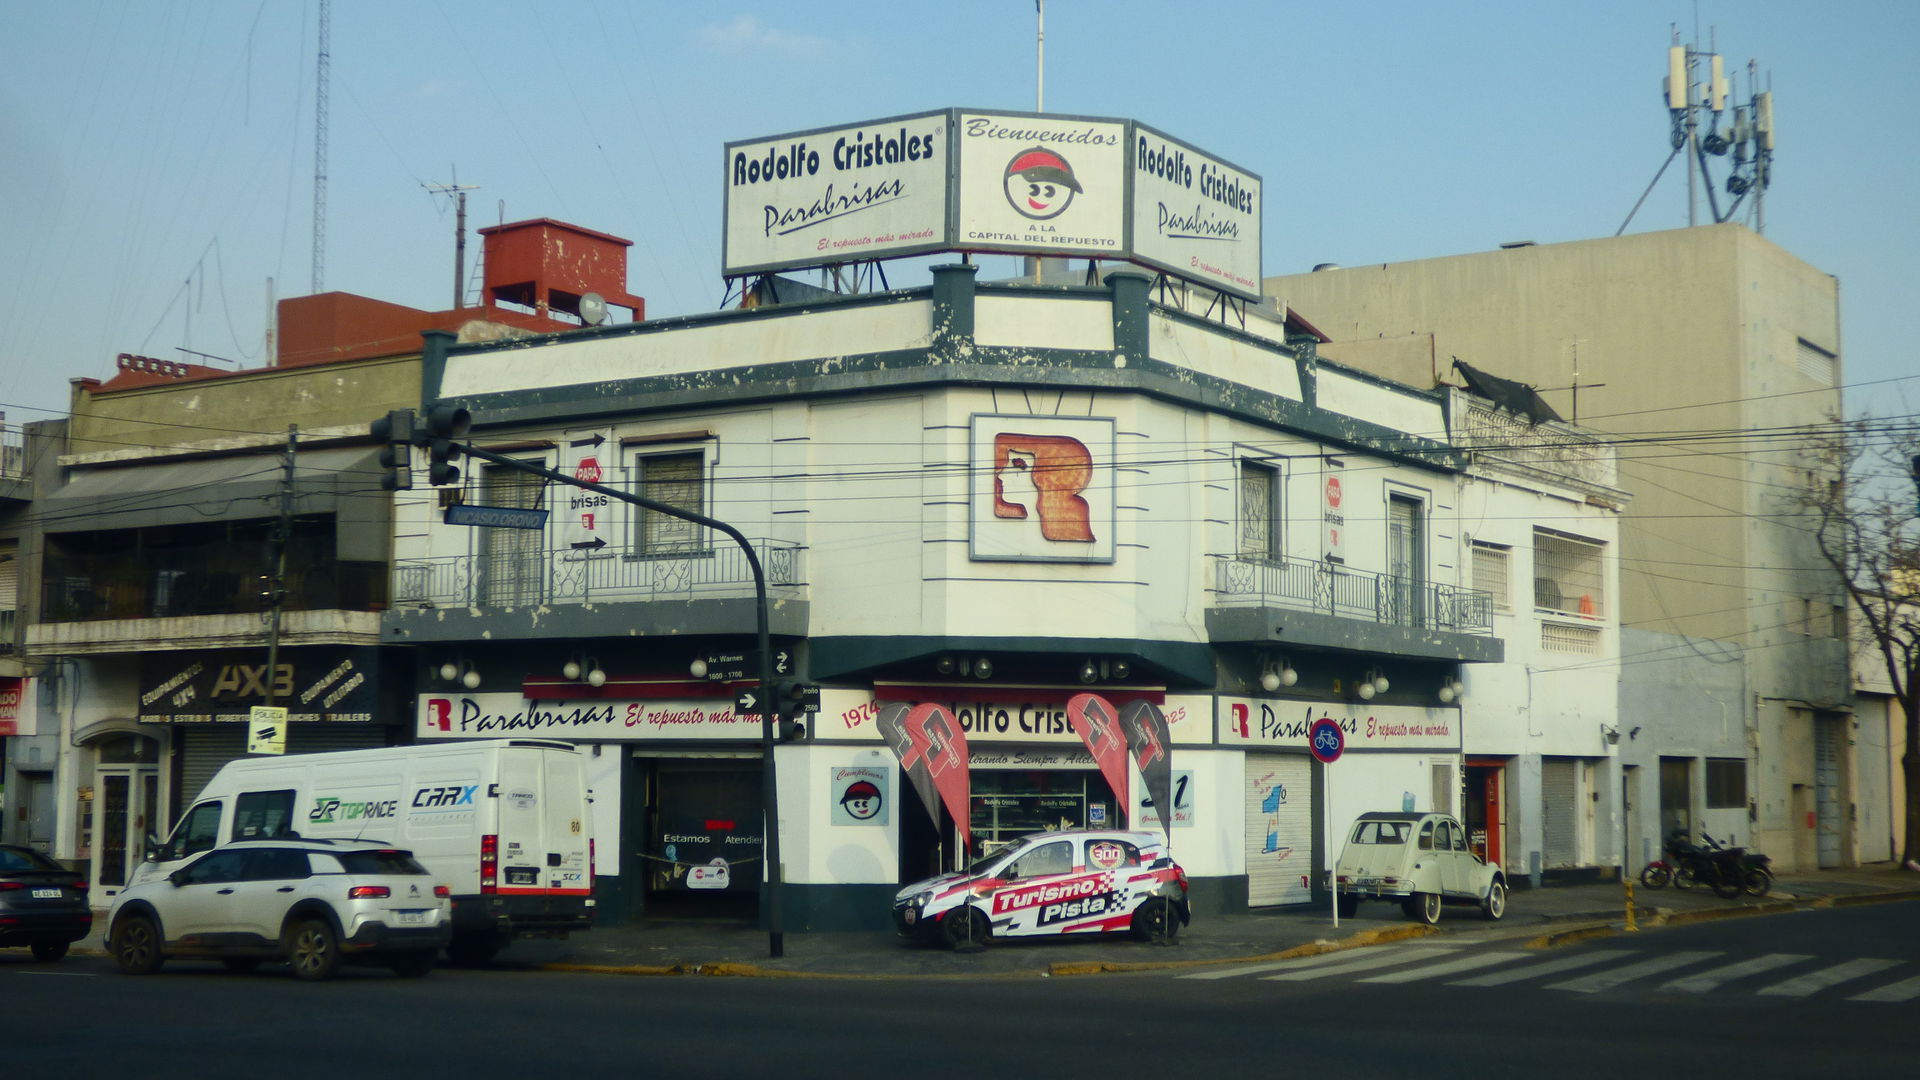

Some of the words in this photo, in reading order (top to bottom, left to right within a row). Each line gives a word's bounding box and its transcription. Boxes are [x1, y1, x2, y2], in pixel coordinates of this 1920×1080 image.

[966, 118, 1119, 146] Bienvenidos
[733, 143, 820, 187] Rodolfo
[833, 128, 933, 171] Cristales
[1138, 135, 1192, 189] Rodolfo
[1200, 163, 1253, 215] Cristales
[763, 178, 906, 238] Parabrisas
[1029, 224, 1037, 232] A
[1041, 225, 1056, 233] LA
[1158, 201, 1240, 238] Parabrisas
[817, 237, 830, 251] El
[832, 236, 872, 250] repuesto
[875, 233, 895, 244] más
[898, 227, 934, 241] mirado
[968, 231, 1020, 241] CAPITAL
[1024, 234, 1047, 243] DEL
[1051, 236, 1116, 247] REPUESTO
[577, 467, 599, 482] PARA
[1327, 485, 1340, 498] PARA
[570, 494, 608, 510] brisas
[454, 511, 500, 525] NICASIO
[501, 513, 540, 528] OROÑO
[1324, 509, 1344, 527] brisas
[719, 654, 743, 663] Warnes
[299, 658, 354, 705] EQUIPAMIENTO
[728, 671, 743, 679] 1700
[322, 672, 365, 709] UTILITARIO
[460, 698, 616, 732] Parabrisas
[624, 703, 644, 727] El
[646, 707, 705, 731] repuesto
[708, 706, 736, 724] más
[841, 701, 881, 730] 1974
[1366, 716, 1377, 739] El
[1379, 718, 1407, 741] repuesto
[1408, 721, 1422, 737] más
[1013, 751, 1059, 766] Siempre
[412, 785, 480, 808] CARX
[571, 821, 580, 832] 80
[663, 834, 711, 843] Estamos
[1094, 850, 1120, 860] 300
[562, 873, 582, 881] SCX
[999, 879, 1095, 910] Turismo
[1042, 897, 1106, 922] Pista
